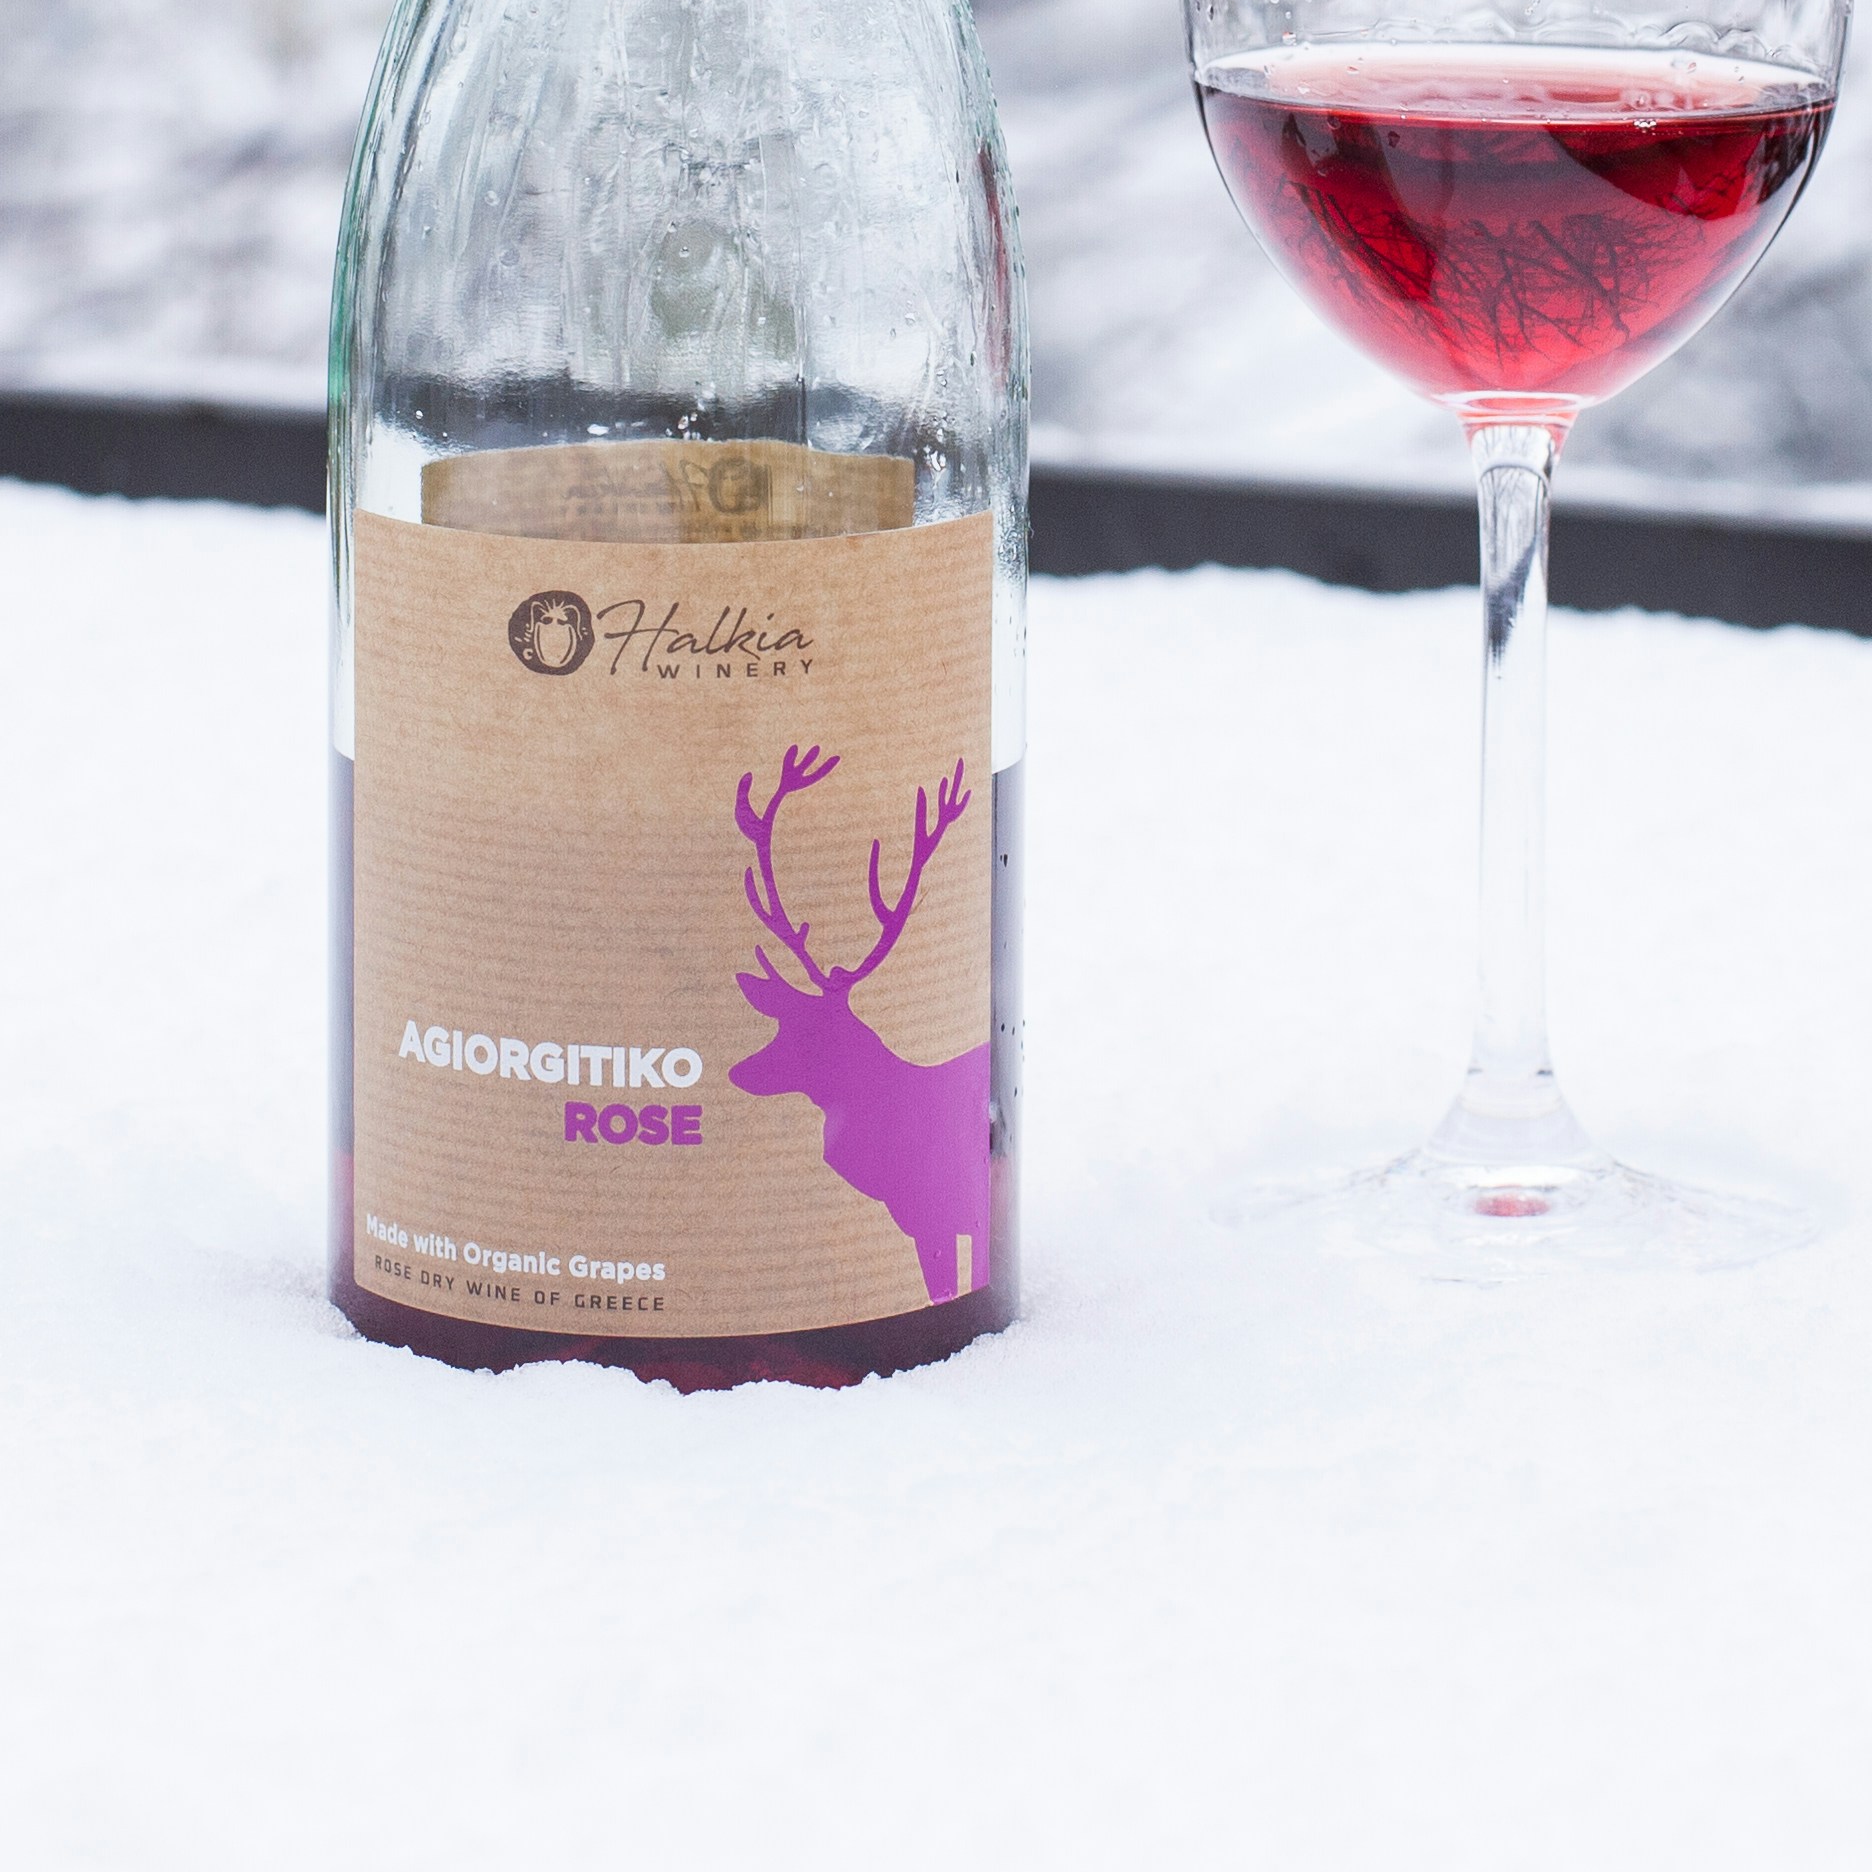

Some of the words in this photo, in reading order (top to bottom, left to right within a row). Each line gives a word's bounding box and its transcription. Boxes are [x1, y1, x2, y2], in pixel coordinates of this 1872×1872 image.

[596, 600, 814, 675] Halkia
[657, 658, 815, 680] WINERY
[398, 1020, 703, 1088] AGIORGITIKO
[564, 1101, 703, 1146] ROSE
[365, 1213, 409, 1249] Made
[413, 1232, 458, 1262] with
[463, 1241, 561, 1275] Organic
[568, 1254, 666, 1285] Grapes
[374, 1254, 412, 1280] ROSE
[420, 1270, 456, 1291] DRY
[466, 1280, 521, 1302] WINE
[534, 1290, 561, 1306] OF
[574, 1294, 666, 1311] GREECE
